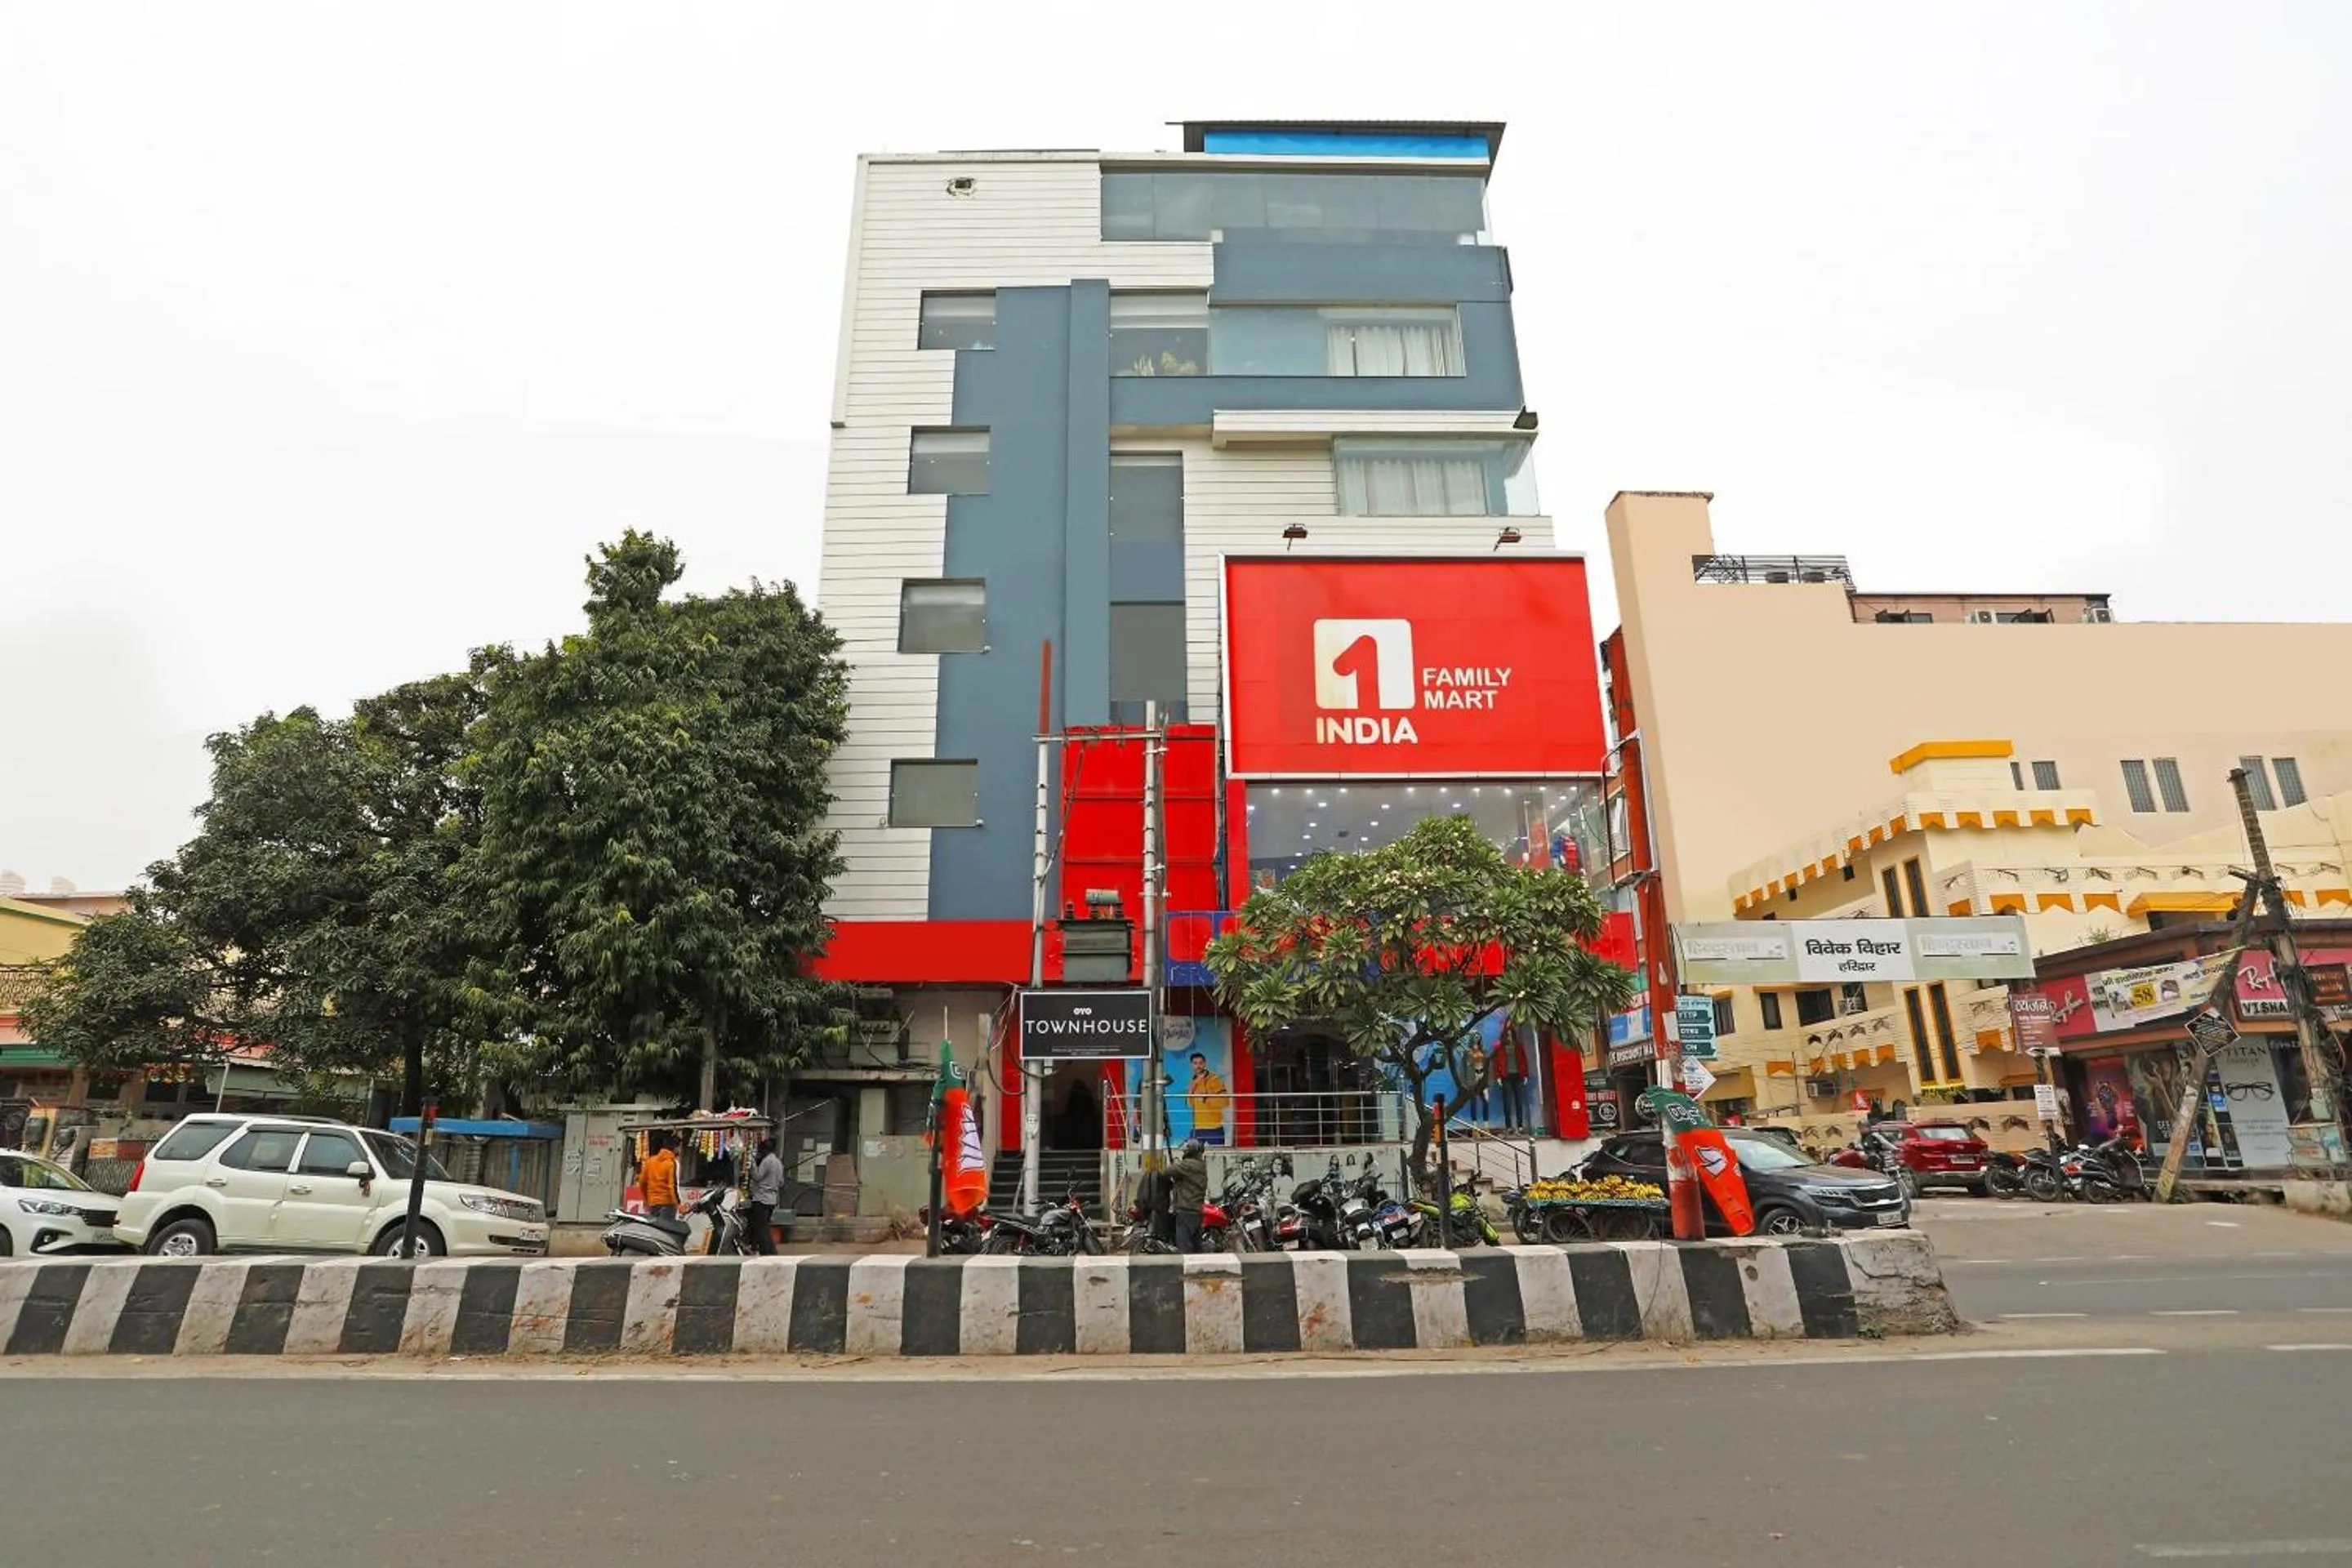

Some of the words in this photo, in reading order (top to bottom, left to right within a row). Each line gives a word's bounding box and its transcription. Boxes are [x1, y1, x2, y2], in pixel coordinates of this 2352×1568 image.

[1423, 667, 1512, 688] FAMILY
[1423, 690, 1499, 710] MART
[1316, 716, 1418, 744] INDIA
[1806, 938, 1852, 956] विवेक
[1856, 938, 1901, 956] विहार
[1838, 959, 1876, 972] हरिद्वार
[1073, 1007, 1093, 1015] OYO
[2243, 1001, 2287, 1013] VISHA
[1025, 1019, 1147, 1035] TOWNHOUSE
[2223, 1046, 2267, 1057] TITAN
